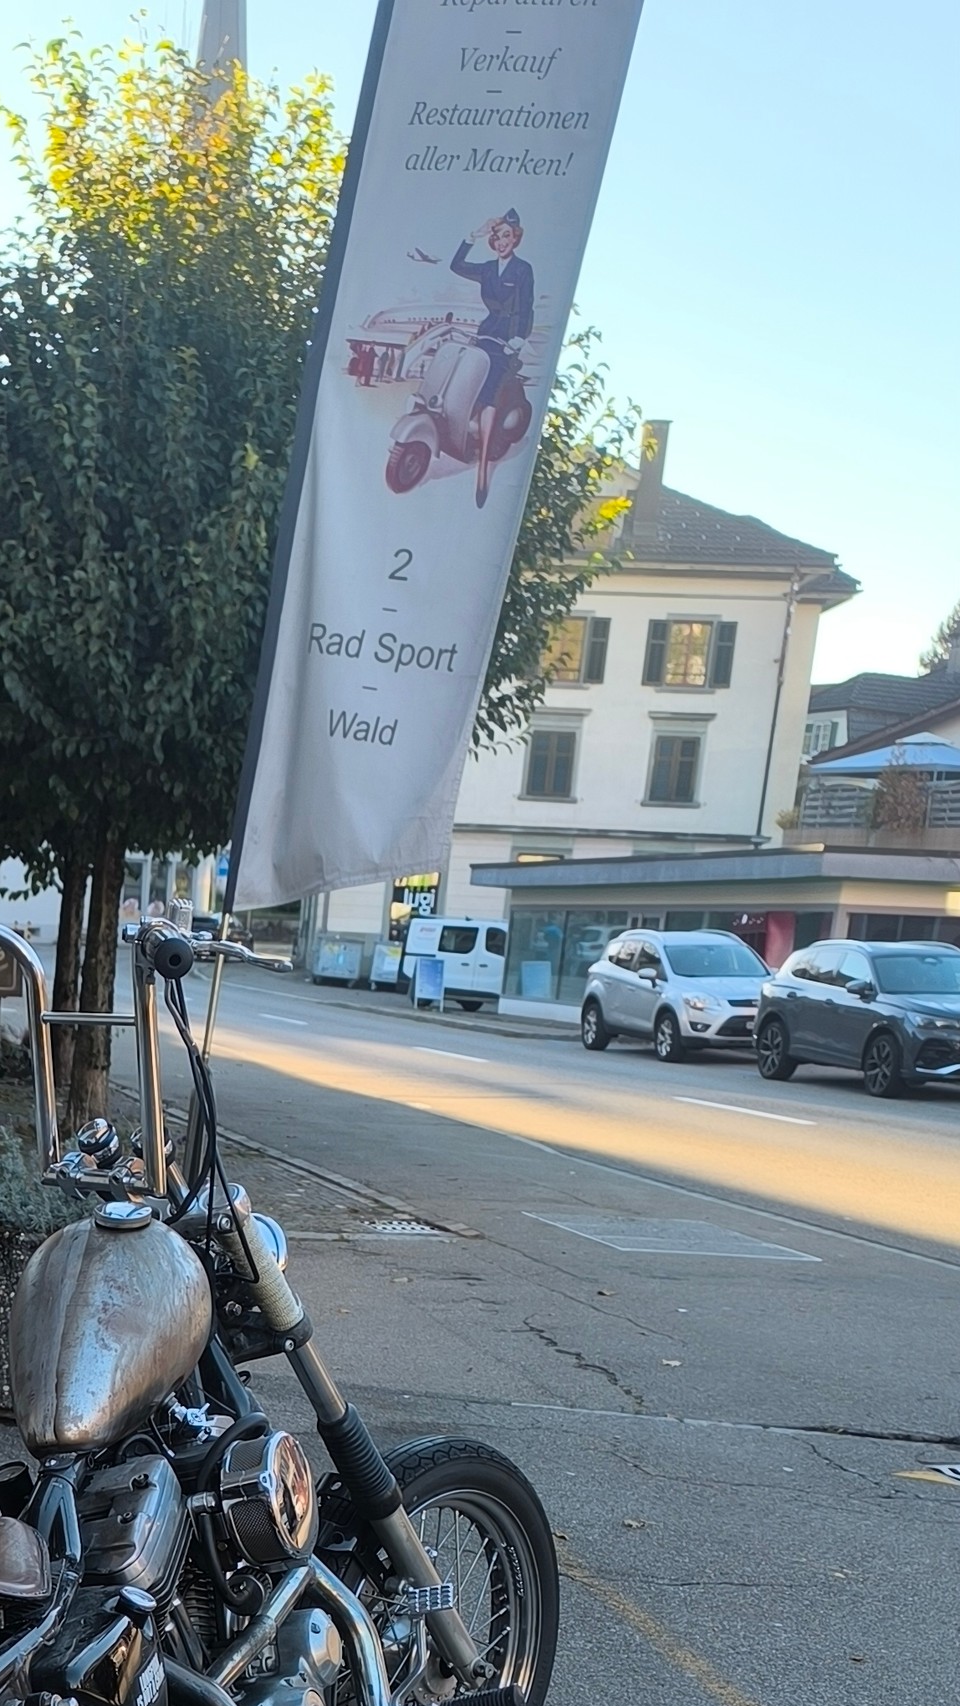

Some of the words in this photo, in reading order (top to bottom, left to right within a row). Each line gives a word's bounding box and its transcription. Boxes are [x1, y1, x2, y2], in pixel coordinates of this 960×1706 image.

[460, 46, 562, 80] Verkauf
[408, 102, 590, 129] Restaurationen
[405, 146, 460, 171] aller
[463, 149, 574, 176] Marken!
[388, 548, 413, 581] 2
[308, 622, 366, 659] Rad
[374, 632, 458, 673] Sport
[329, 708, 398, 746] Wald
